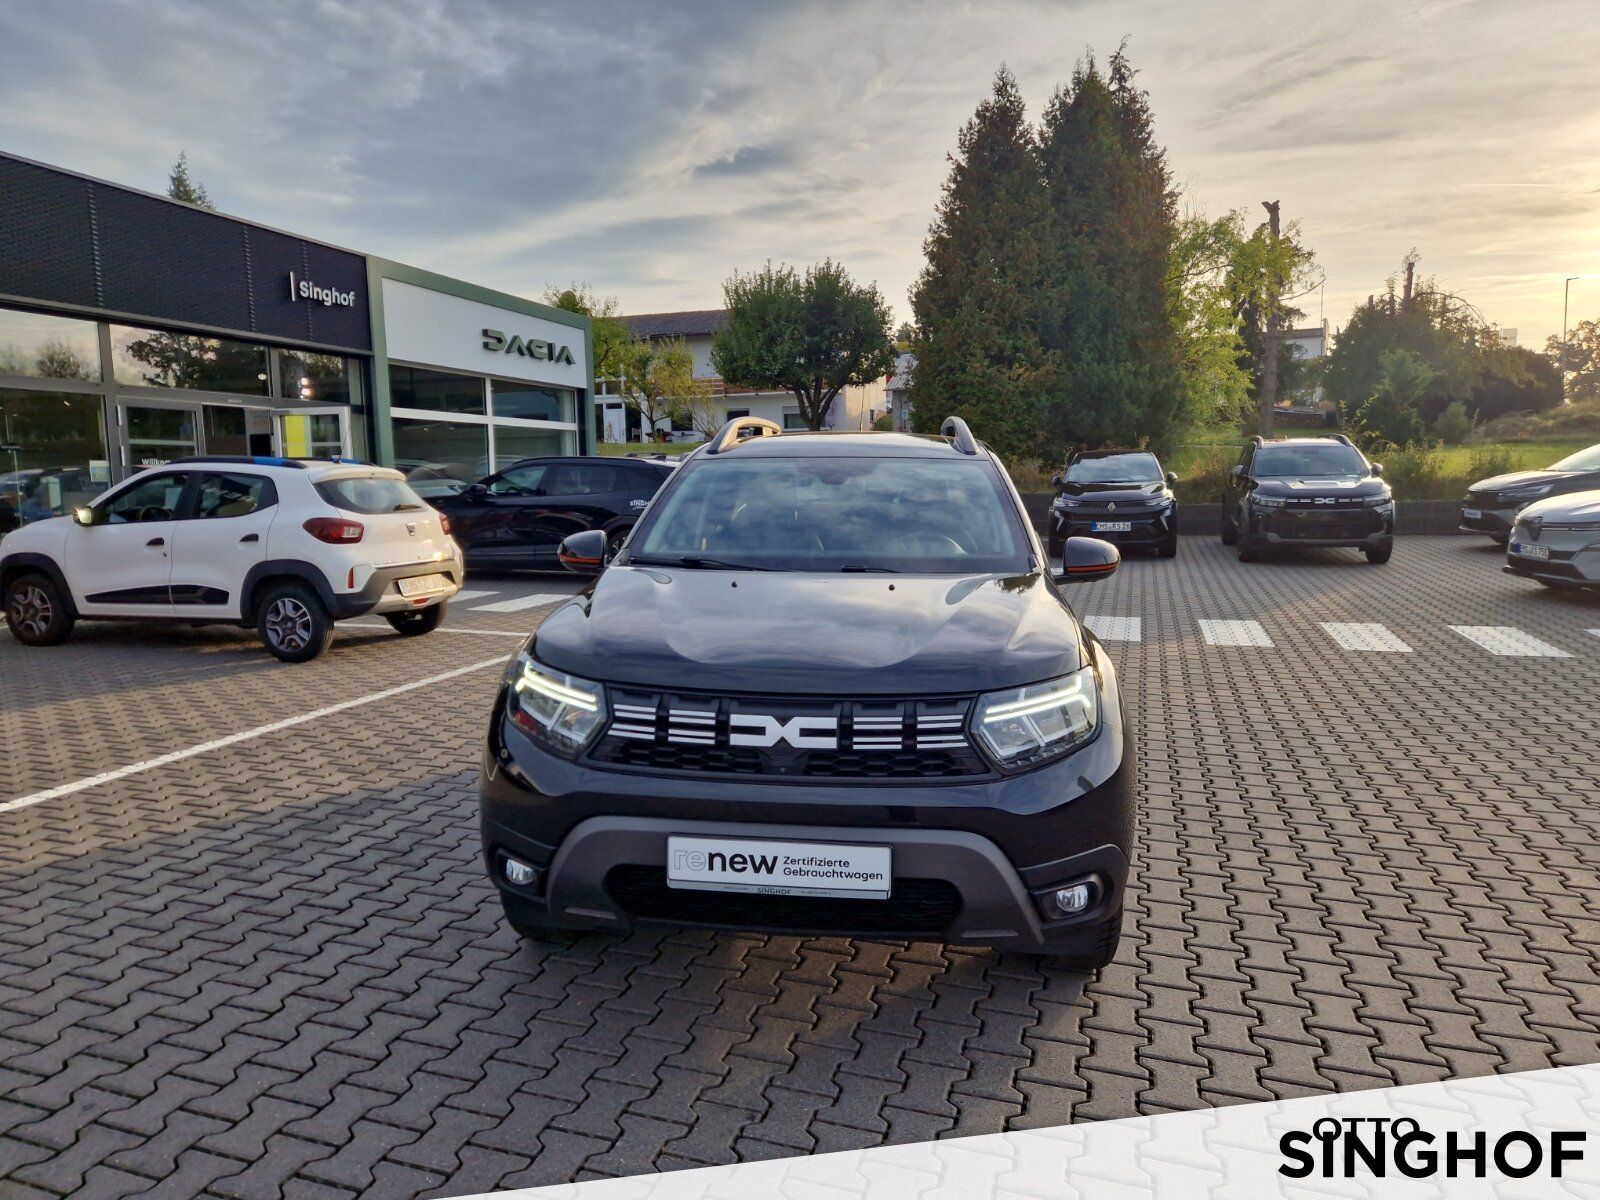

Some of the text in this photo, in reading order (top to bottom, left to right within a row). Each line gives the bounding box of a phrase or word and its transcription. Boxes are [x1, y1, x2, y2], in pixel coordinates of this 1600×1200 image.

[299, 281, 355, 307] Singhof
[481, 328, 577, 366] DACIA
[674, 849, 850, 875] renew Zertifizierte
[783, 866, 883, 882] Gebrauchtwagen
[757, 886, 791, 896] SINGHOF
